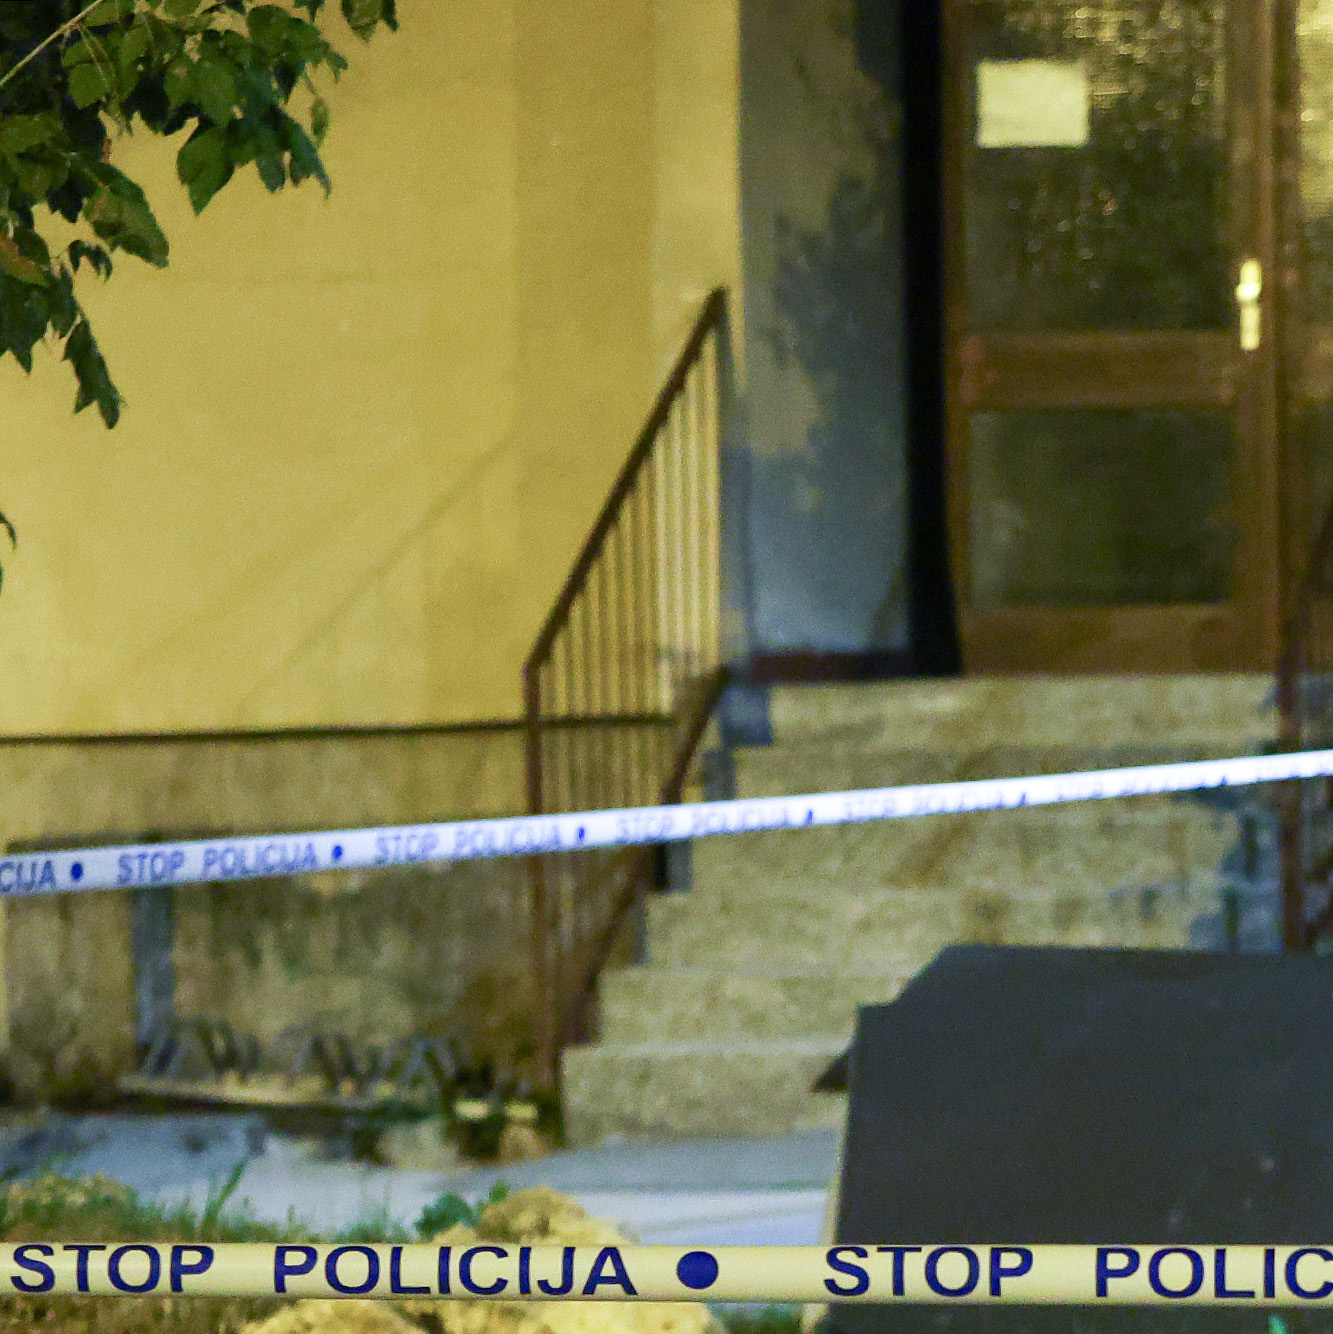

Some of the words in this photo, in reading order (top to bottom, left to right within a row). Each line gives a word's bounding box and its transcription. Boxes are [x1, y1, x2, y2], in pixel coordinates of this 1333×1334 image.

[0, 860, 56, 894] CIJA
[117, 851, 186, 885] STOP
[203, 842, 316, 882] POLICIJA
[13, 1243, 215, 1294] STOP
[274, 1243, 637, 1297] POLICIJA
[824, 1244, 1034, 1299] STOP
